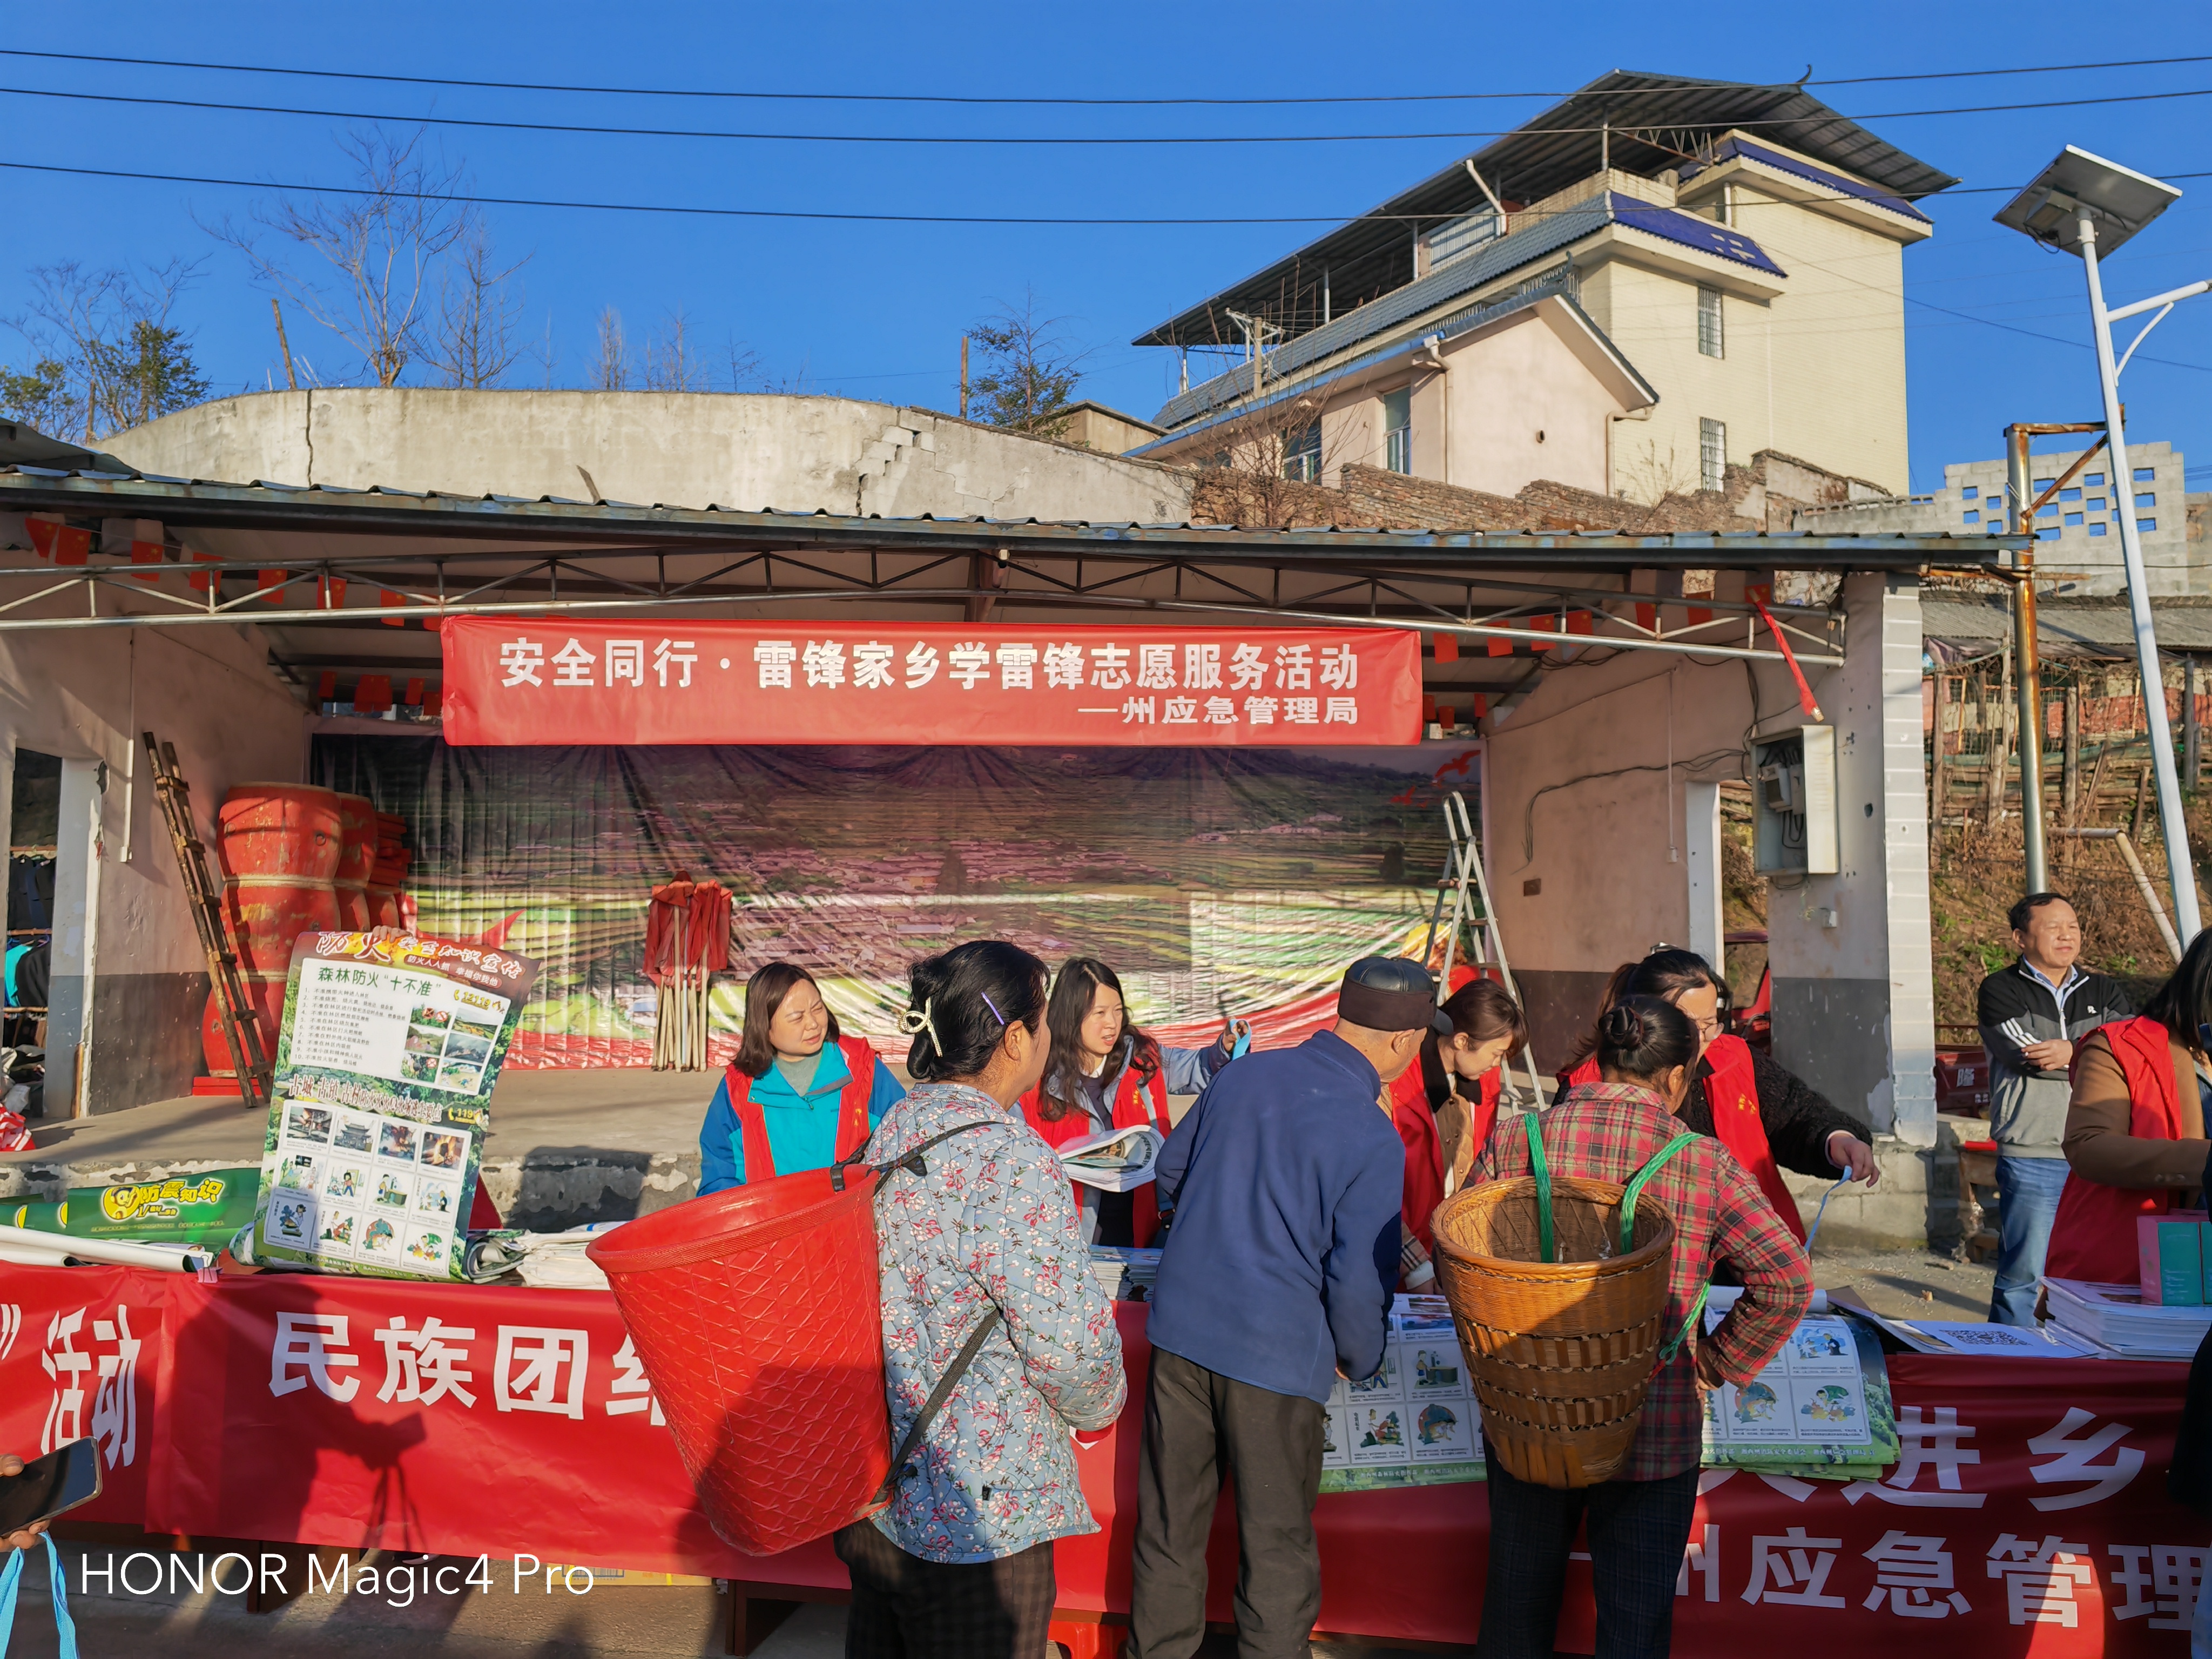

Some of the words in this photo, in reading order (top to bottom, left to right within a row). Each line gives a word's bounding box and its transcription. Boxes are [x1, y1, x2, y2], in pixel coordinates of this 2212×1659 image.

[455, 967, 498, 986] 幸福你我他
[456, 1108, 474, 1119] 119
[139, 1178, 223, 1203] 防震知识
